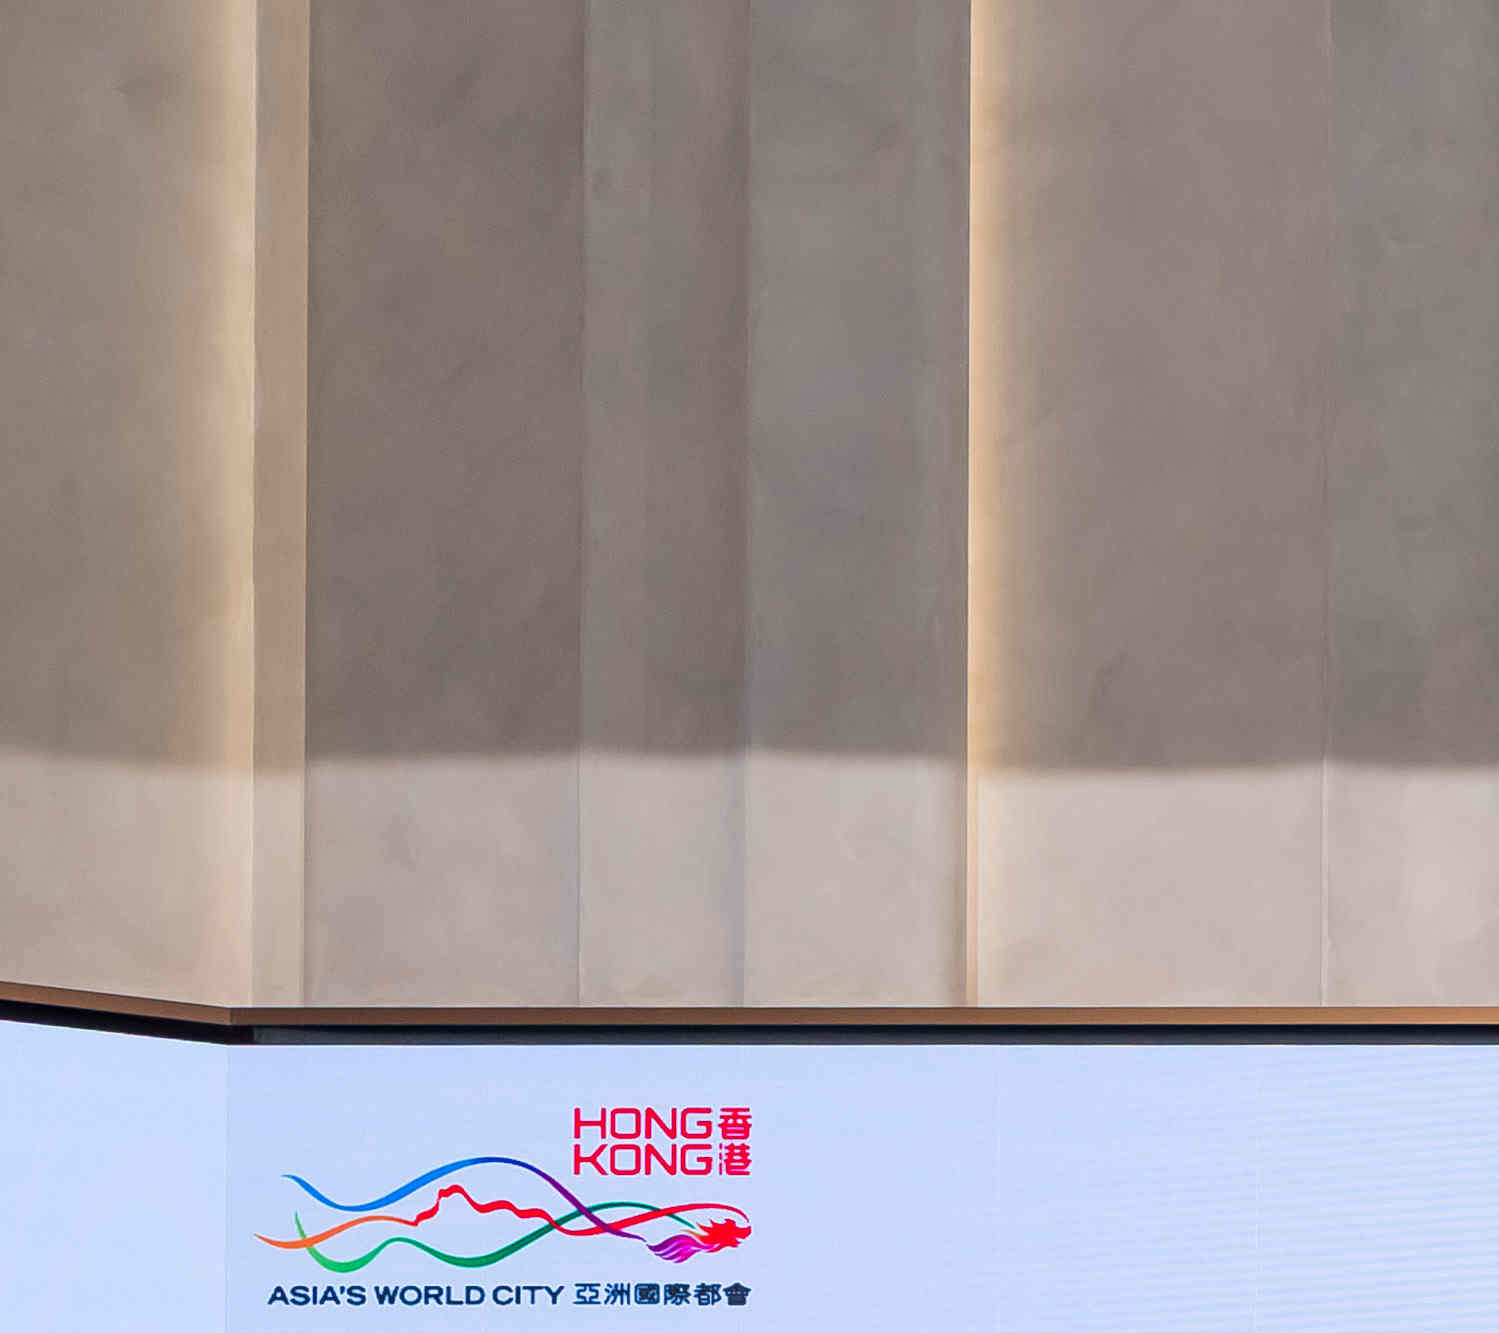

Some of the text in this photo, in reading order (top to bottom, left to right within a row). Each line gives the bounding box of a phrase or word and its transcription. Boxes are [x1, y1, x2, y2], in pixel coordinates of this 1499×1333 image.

[573, 1107, 713, 1140] HONG
[718, 1107, 752, 1140] 香
[573, 1142, 713, 1176] KONG
[718, 1142, 752, 1177] 港
[267, 1284, 564, 1306] ASIA'S WORLD CITY
[573, 1282, 752, 1306] 亞洲國際都會
